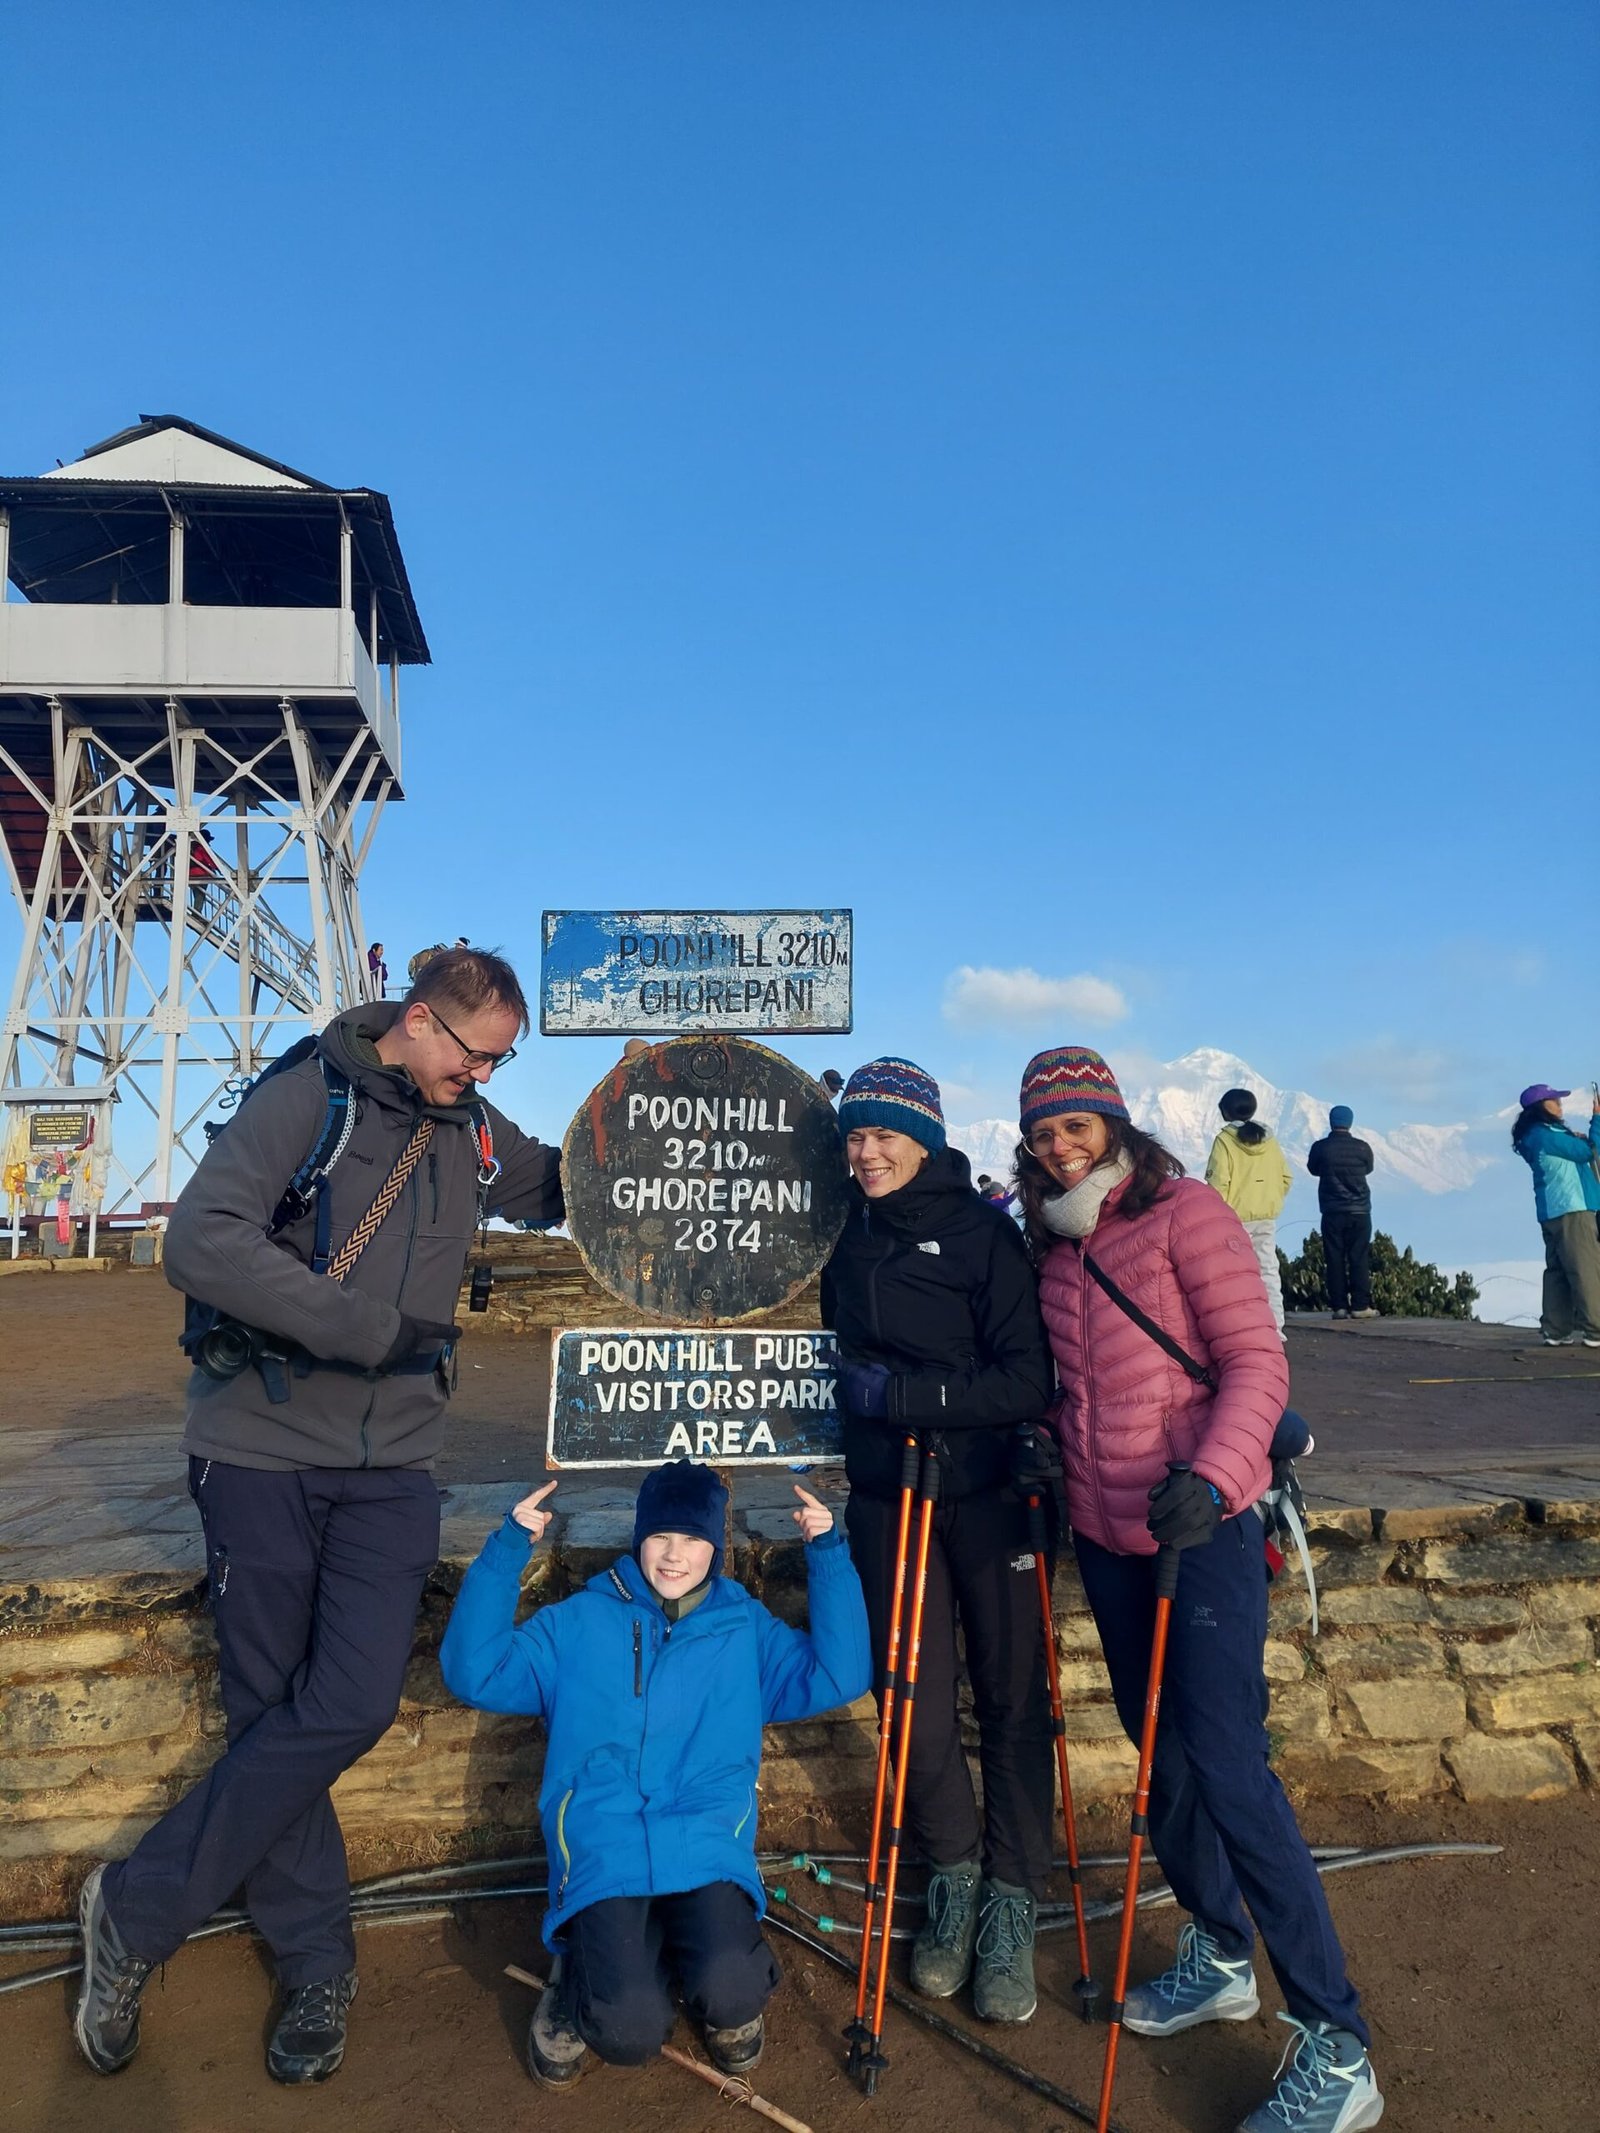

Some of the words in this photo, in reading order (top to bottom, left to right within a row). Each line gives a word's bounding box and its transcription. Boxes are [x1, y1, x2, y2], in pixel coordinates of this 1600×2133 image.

[639, 979, 814, 1014] GHOREPANI
[612, 1176, 811, 1216] GHOREPANI
[674, 1219, 762, 1253] 2874
[663, 1421, 777, 1455] AREA
